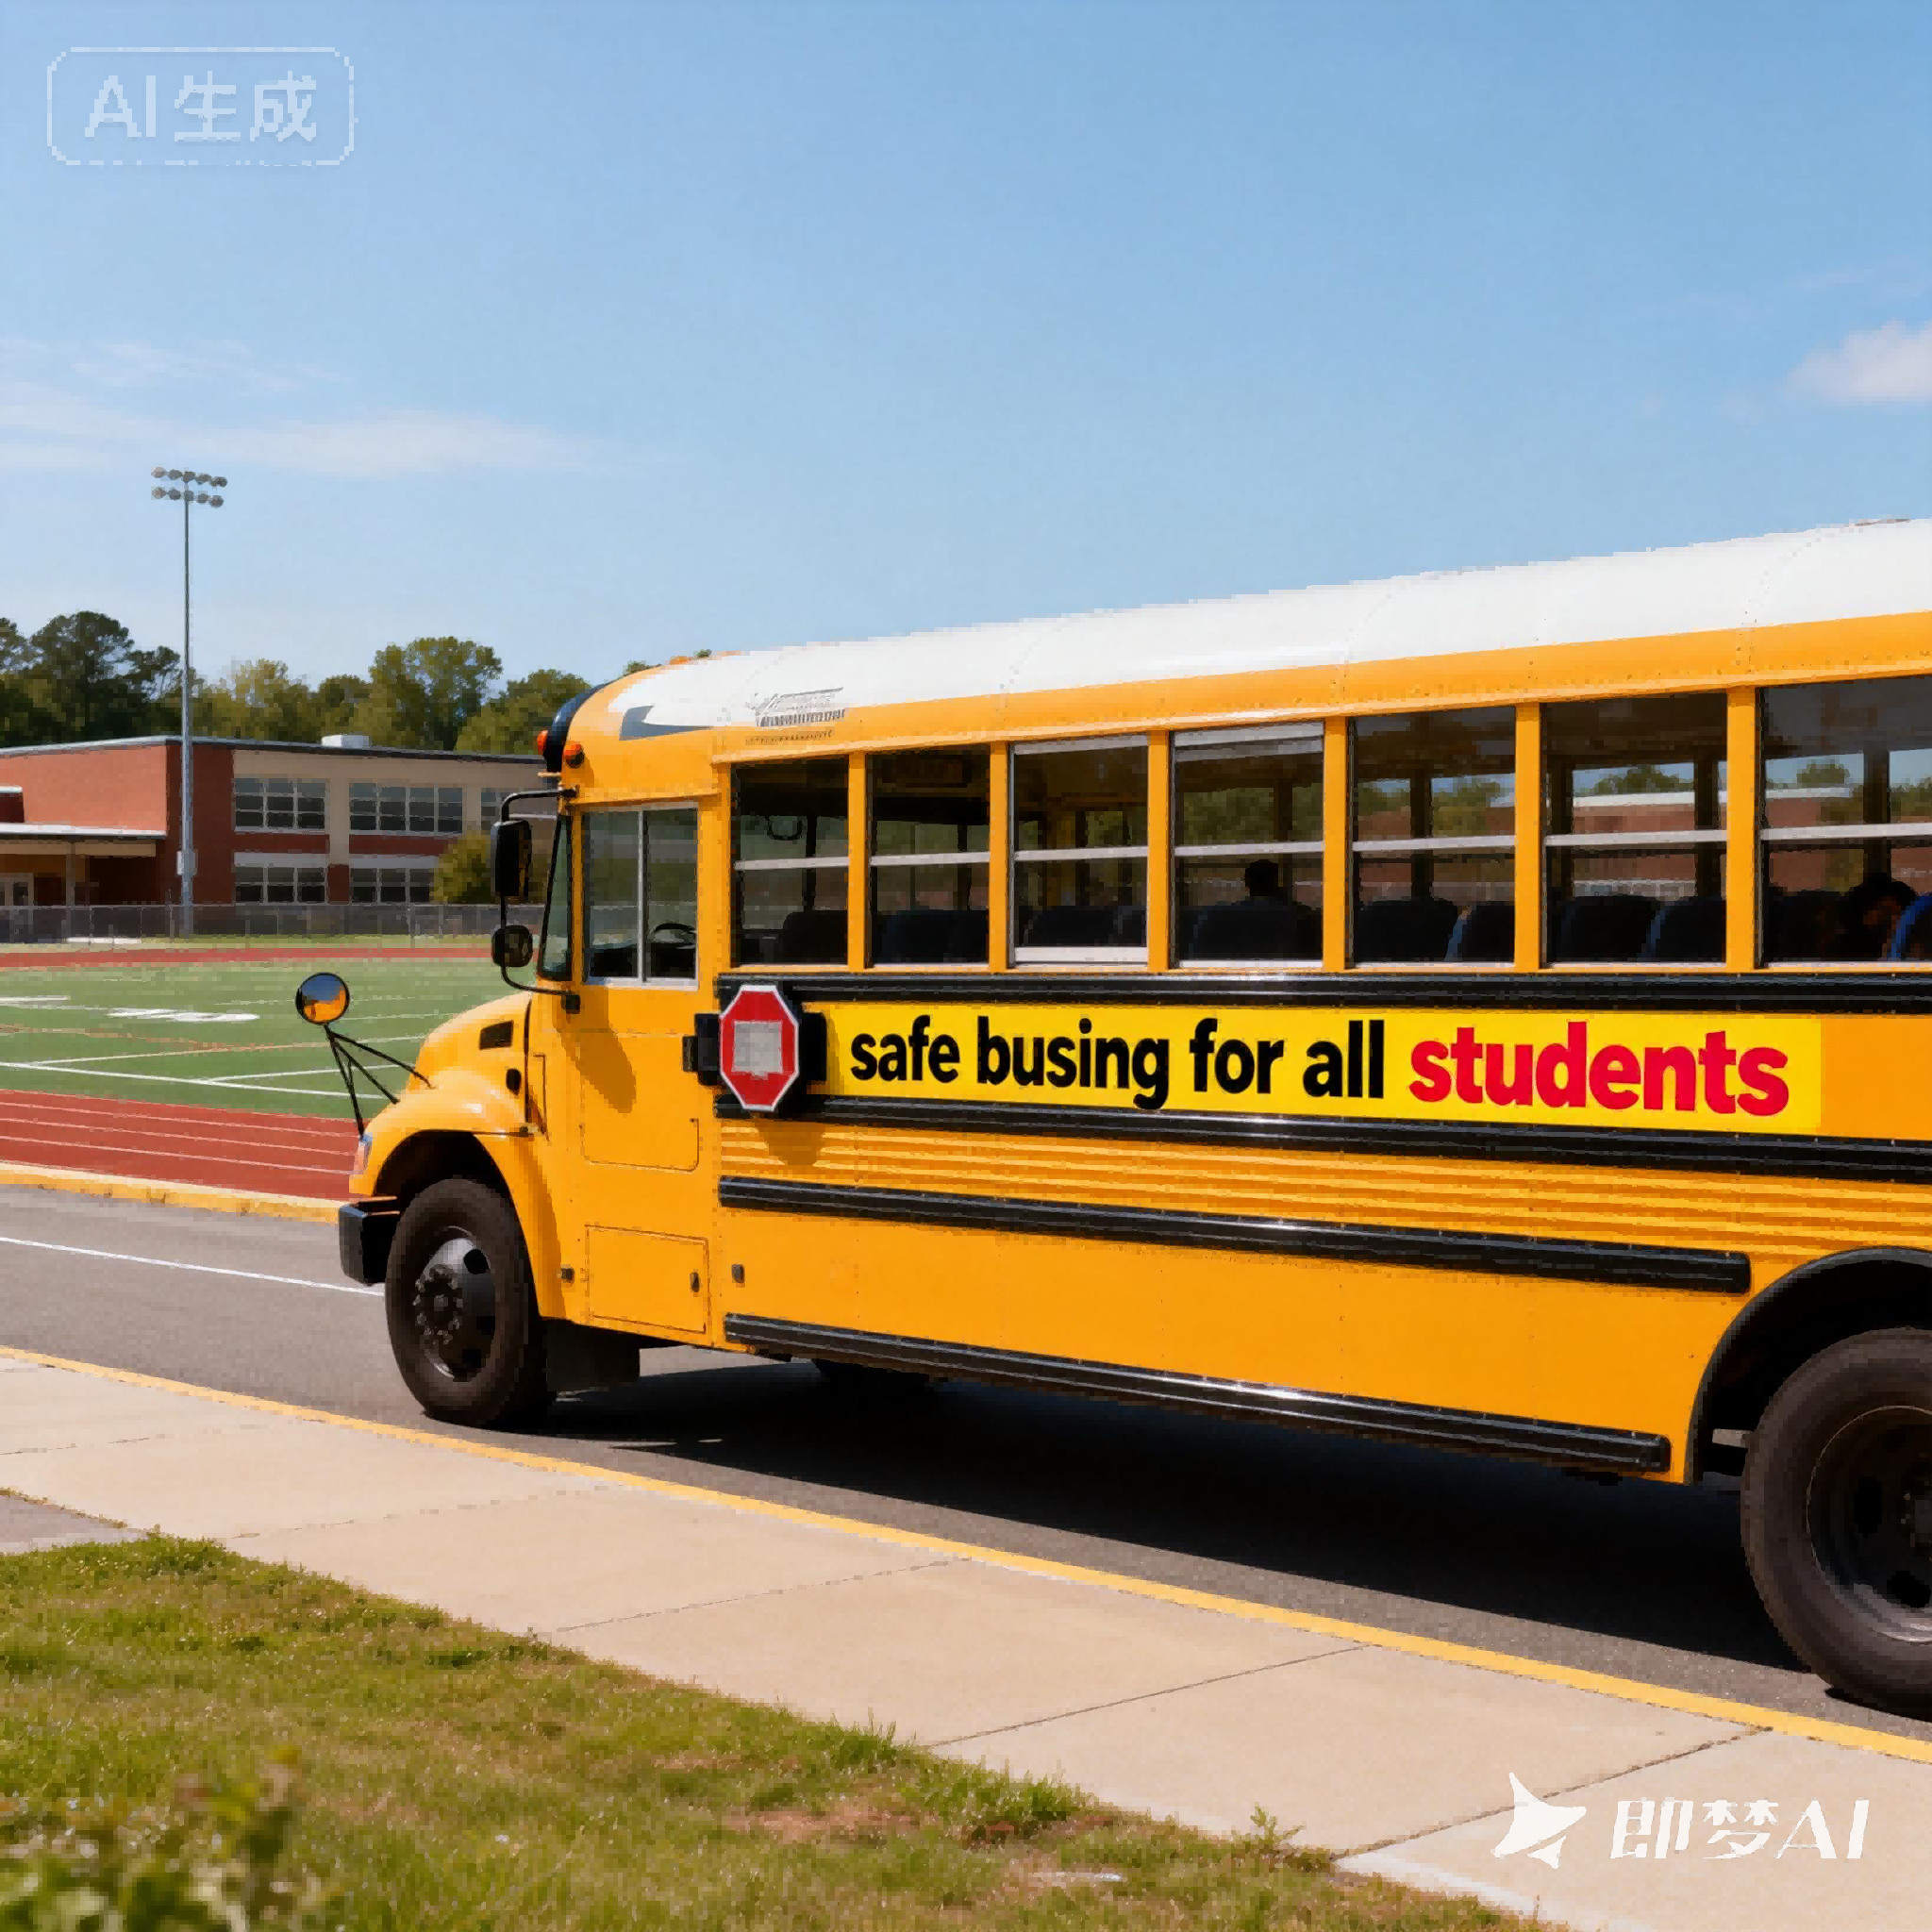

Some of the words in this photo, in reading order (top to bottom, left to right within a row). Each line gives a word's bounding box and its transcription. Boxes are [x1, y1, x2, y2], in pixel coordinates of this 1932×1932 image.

[850, 1014, 961, 1083] safe
[976, 1015, 1170, 1110] busing
[1190, 1018, 1285, 1094] for
[1303, 1019, 1385, 1099] all
[1408, 1021, 1790, 1117] students
